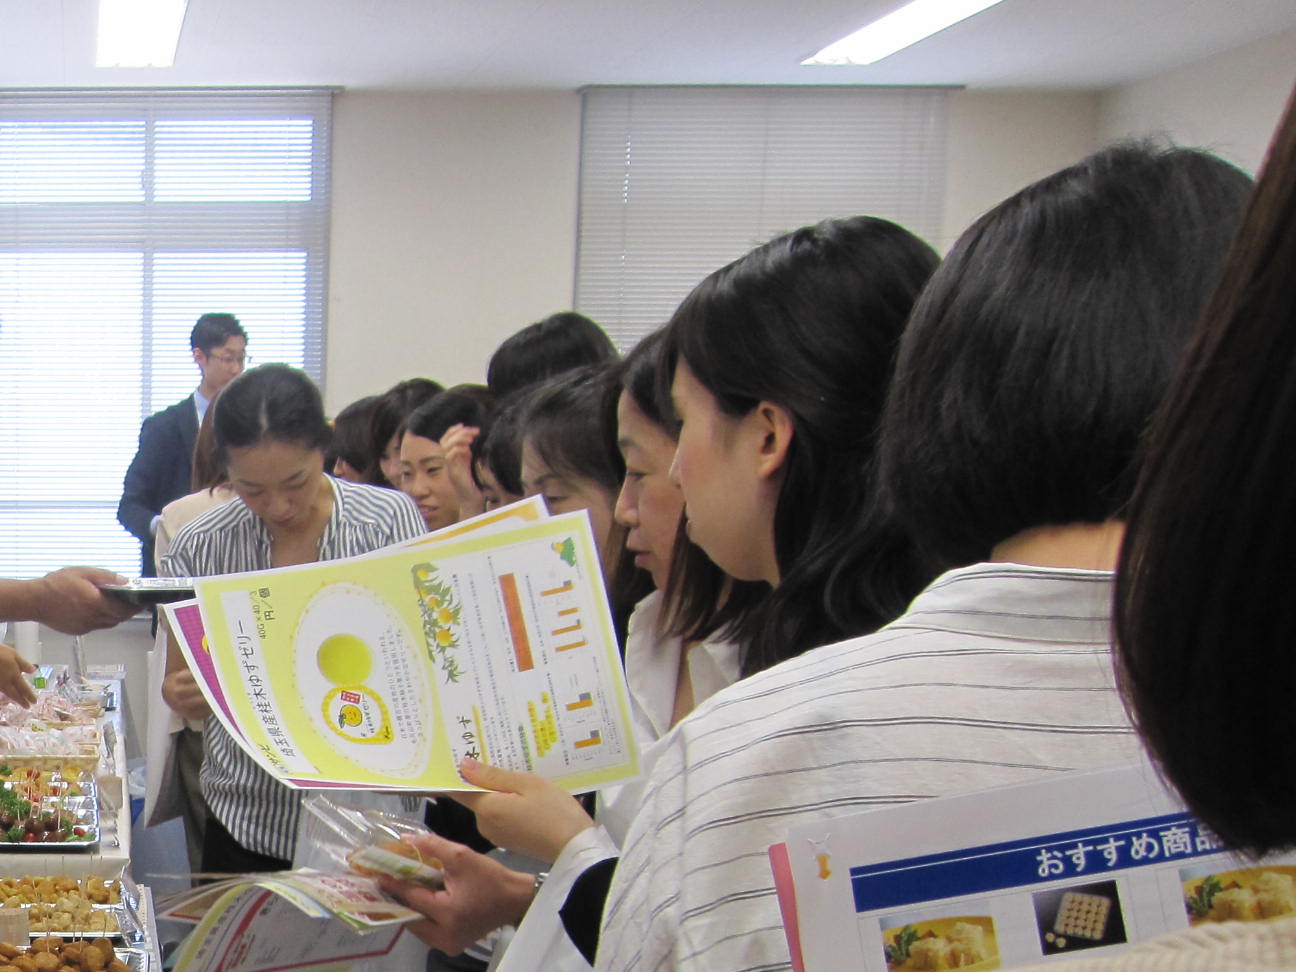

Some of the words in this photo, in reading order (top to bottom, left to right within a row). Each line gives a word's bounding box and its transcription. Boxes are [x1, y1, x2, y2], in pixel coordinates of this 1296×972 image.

[236, 619, 296, 757] 埼玉県産桂木ゆずゼリー
[1036, 826, 1224, 877] おすすめ商品
